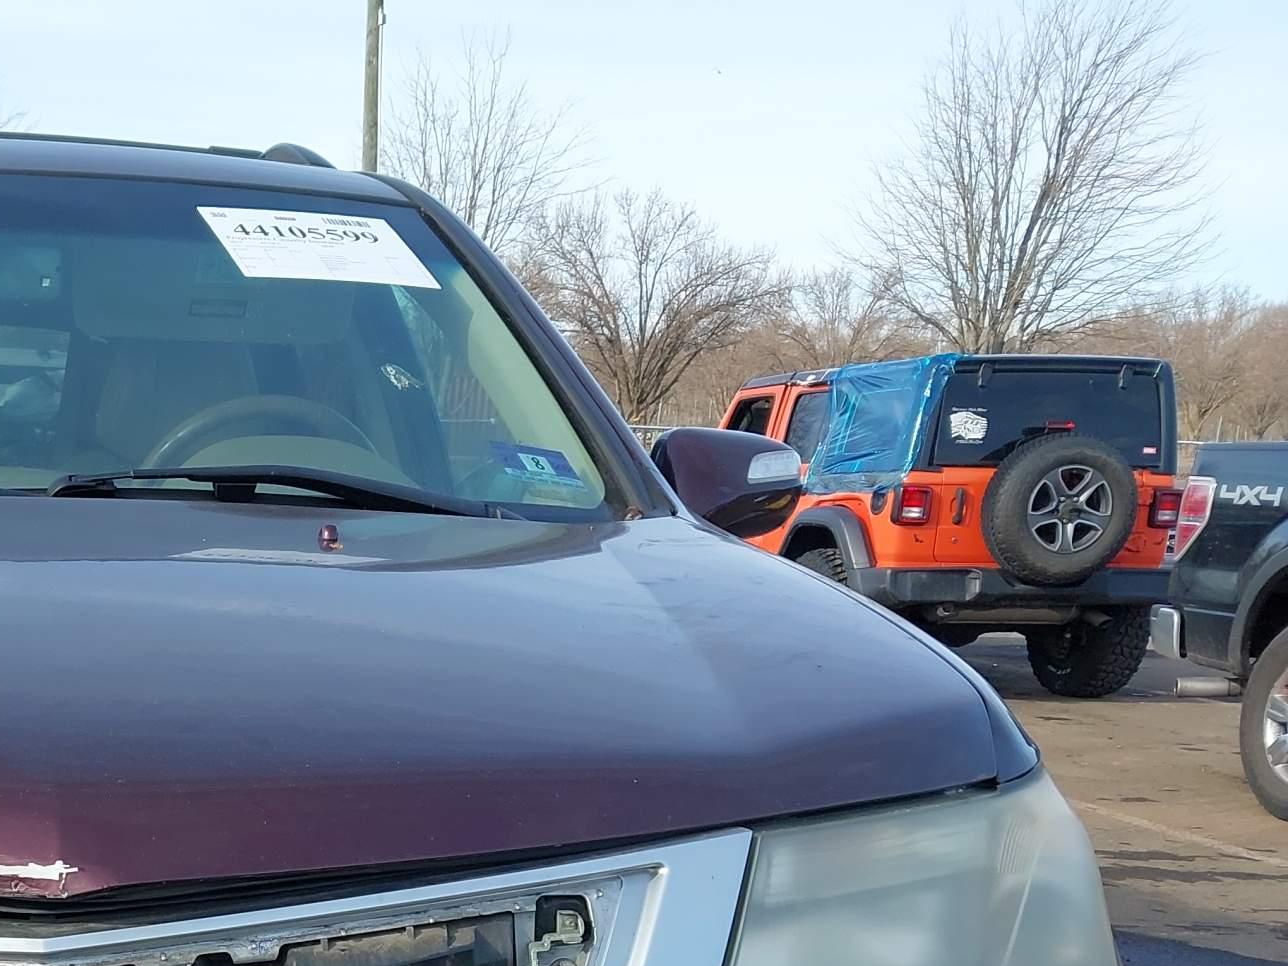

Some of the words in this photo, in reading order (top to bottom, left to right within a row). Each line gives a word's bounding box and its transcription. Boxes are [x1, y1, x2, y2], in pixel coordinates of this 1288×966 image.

[233, 223, 379, 244] 44105599
[531, 456, 545, 471] 8
[1219, 484, 1285, 507] 4X4
